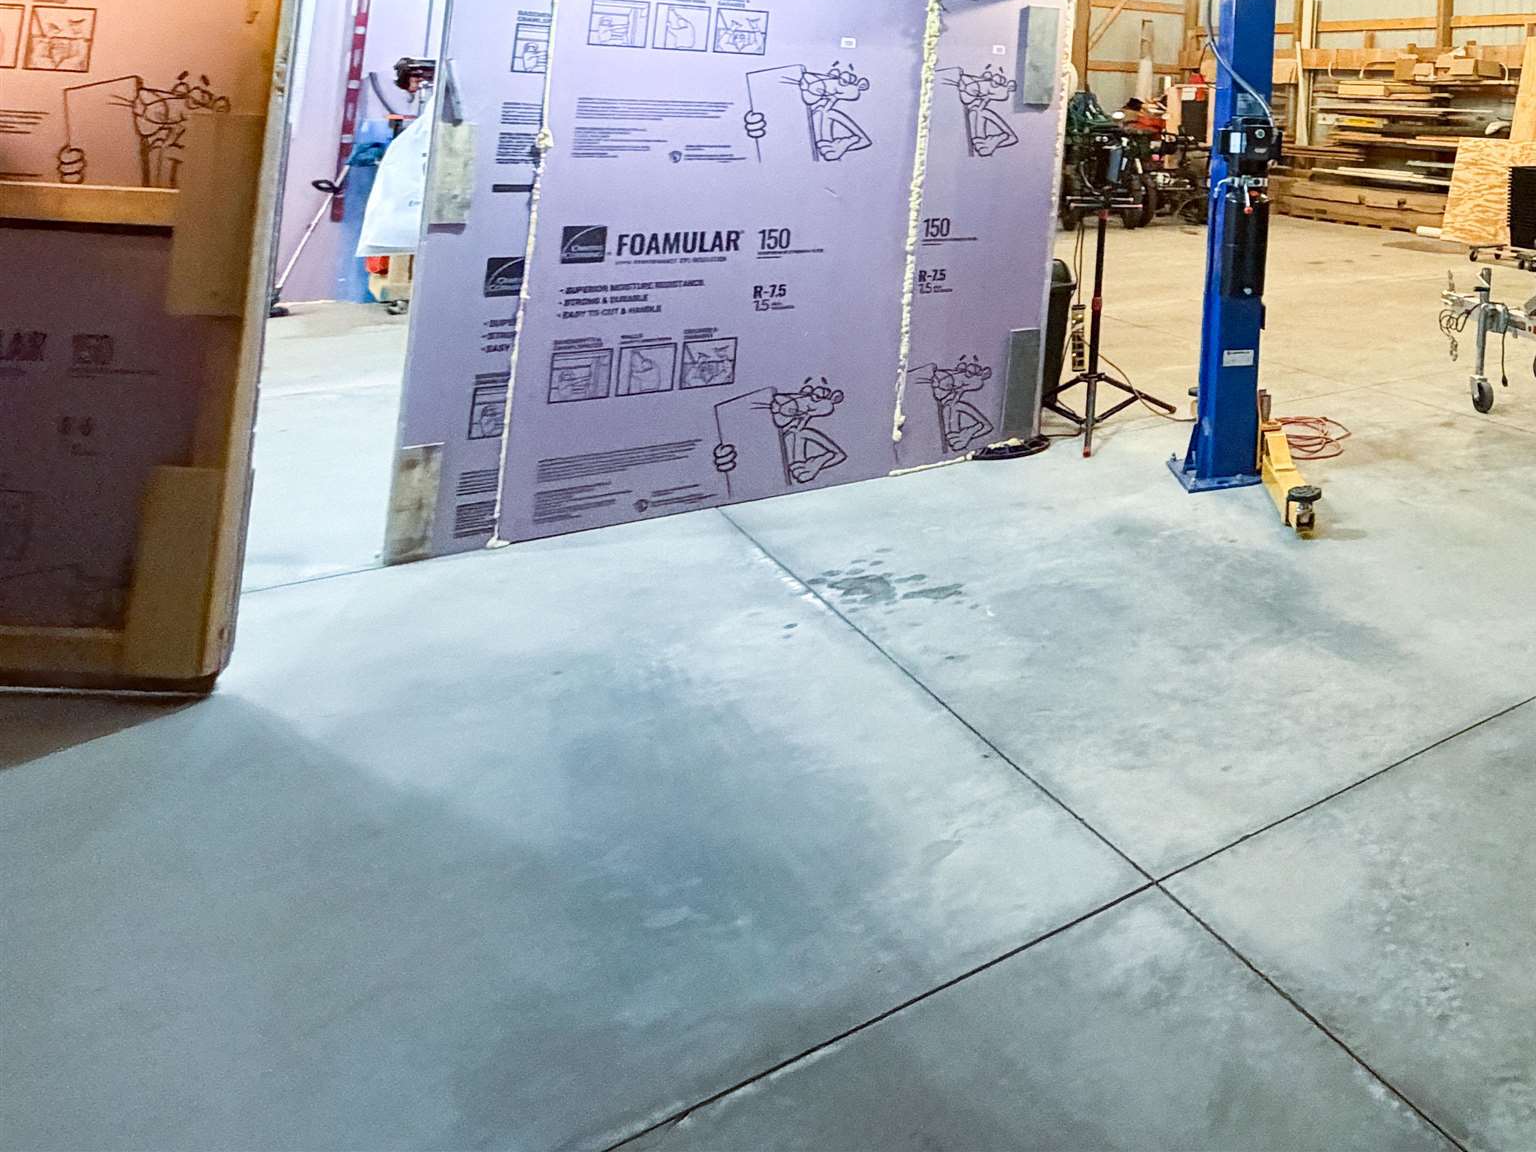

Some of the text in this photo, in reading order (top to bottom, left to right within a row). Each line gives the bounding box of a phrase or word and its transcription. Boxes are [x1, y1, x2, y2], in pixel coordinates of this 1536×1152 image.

[922, 217, 950, 238] 150
[616, 228, 791, 256] FOAMULAR 150
[753, 284, 786, 299] R-7.5
